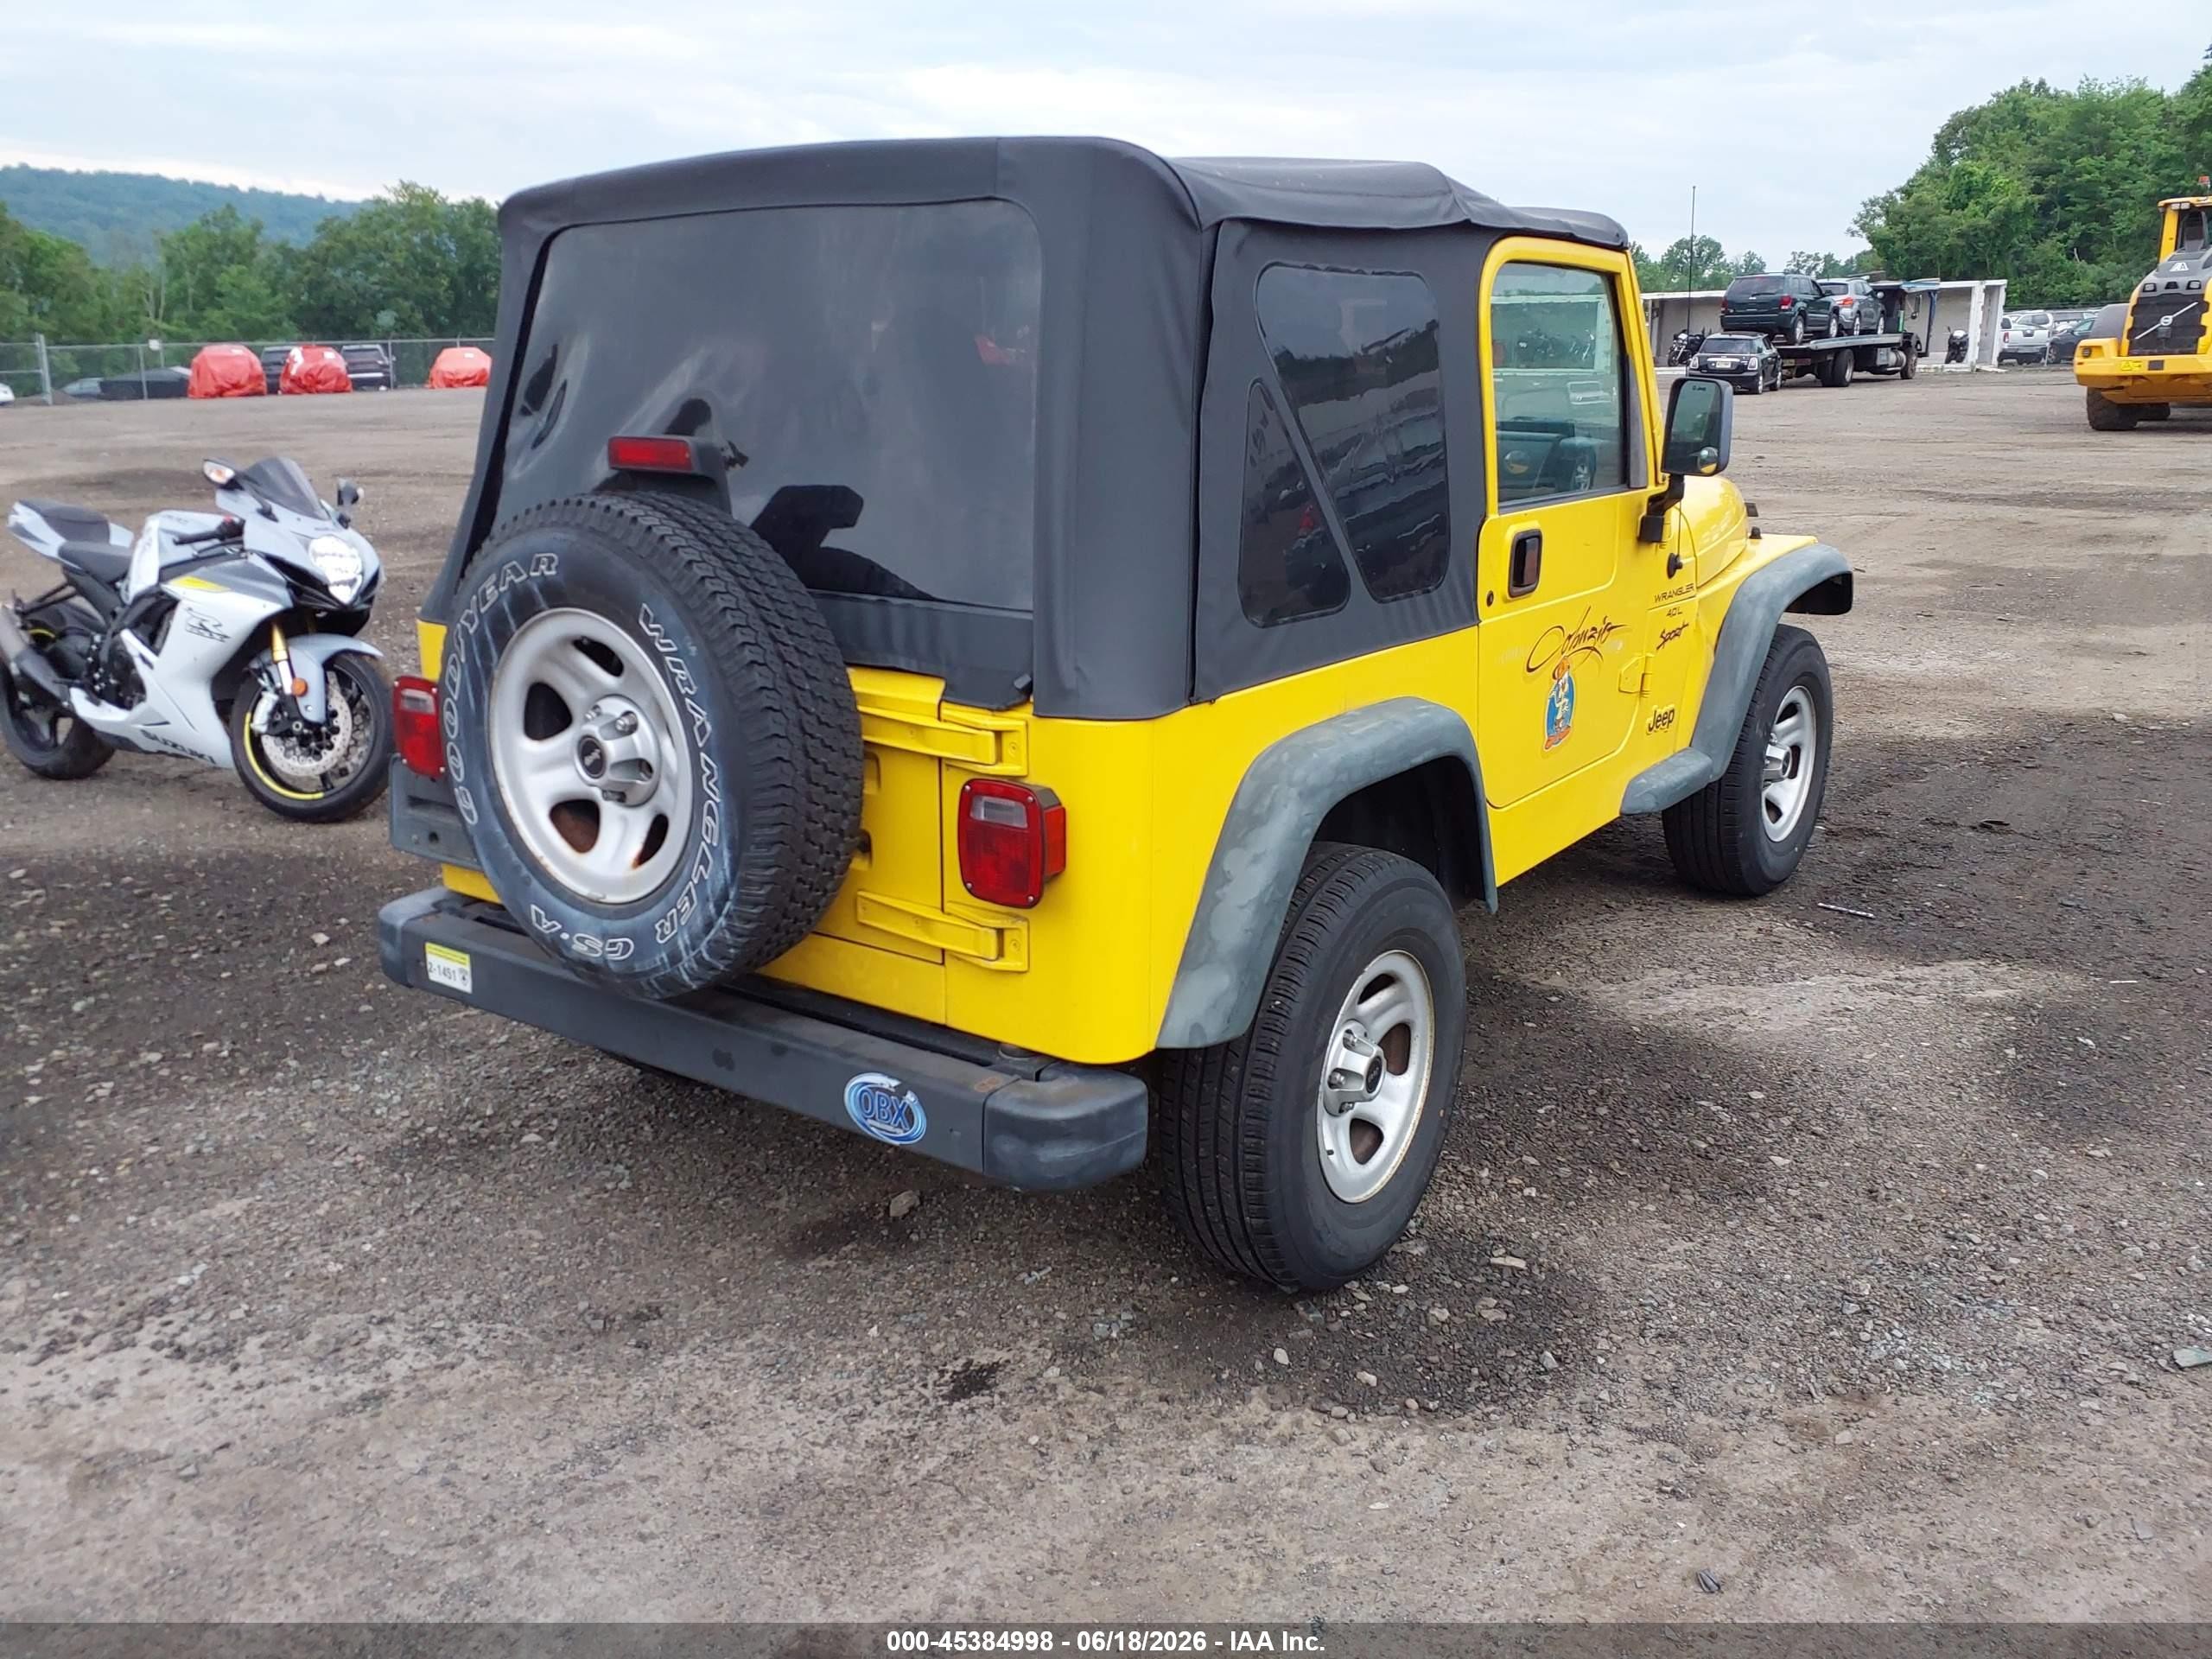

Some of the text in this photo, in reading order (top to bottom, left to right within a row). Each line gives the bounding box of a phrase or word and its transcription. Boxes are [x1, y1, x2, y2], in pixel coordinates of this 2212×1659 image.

[1654, 582, 1694, 603] WRANGLER
[443, 552, 559, 826] GOODYEAR
[1648, 707, 1675, 733] Jeep
[639, 602, 719, 944] WRANGLER
[858, 1087, 911, 1131] OBX
